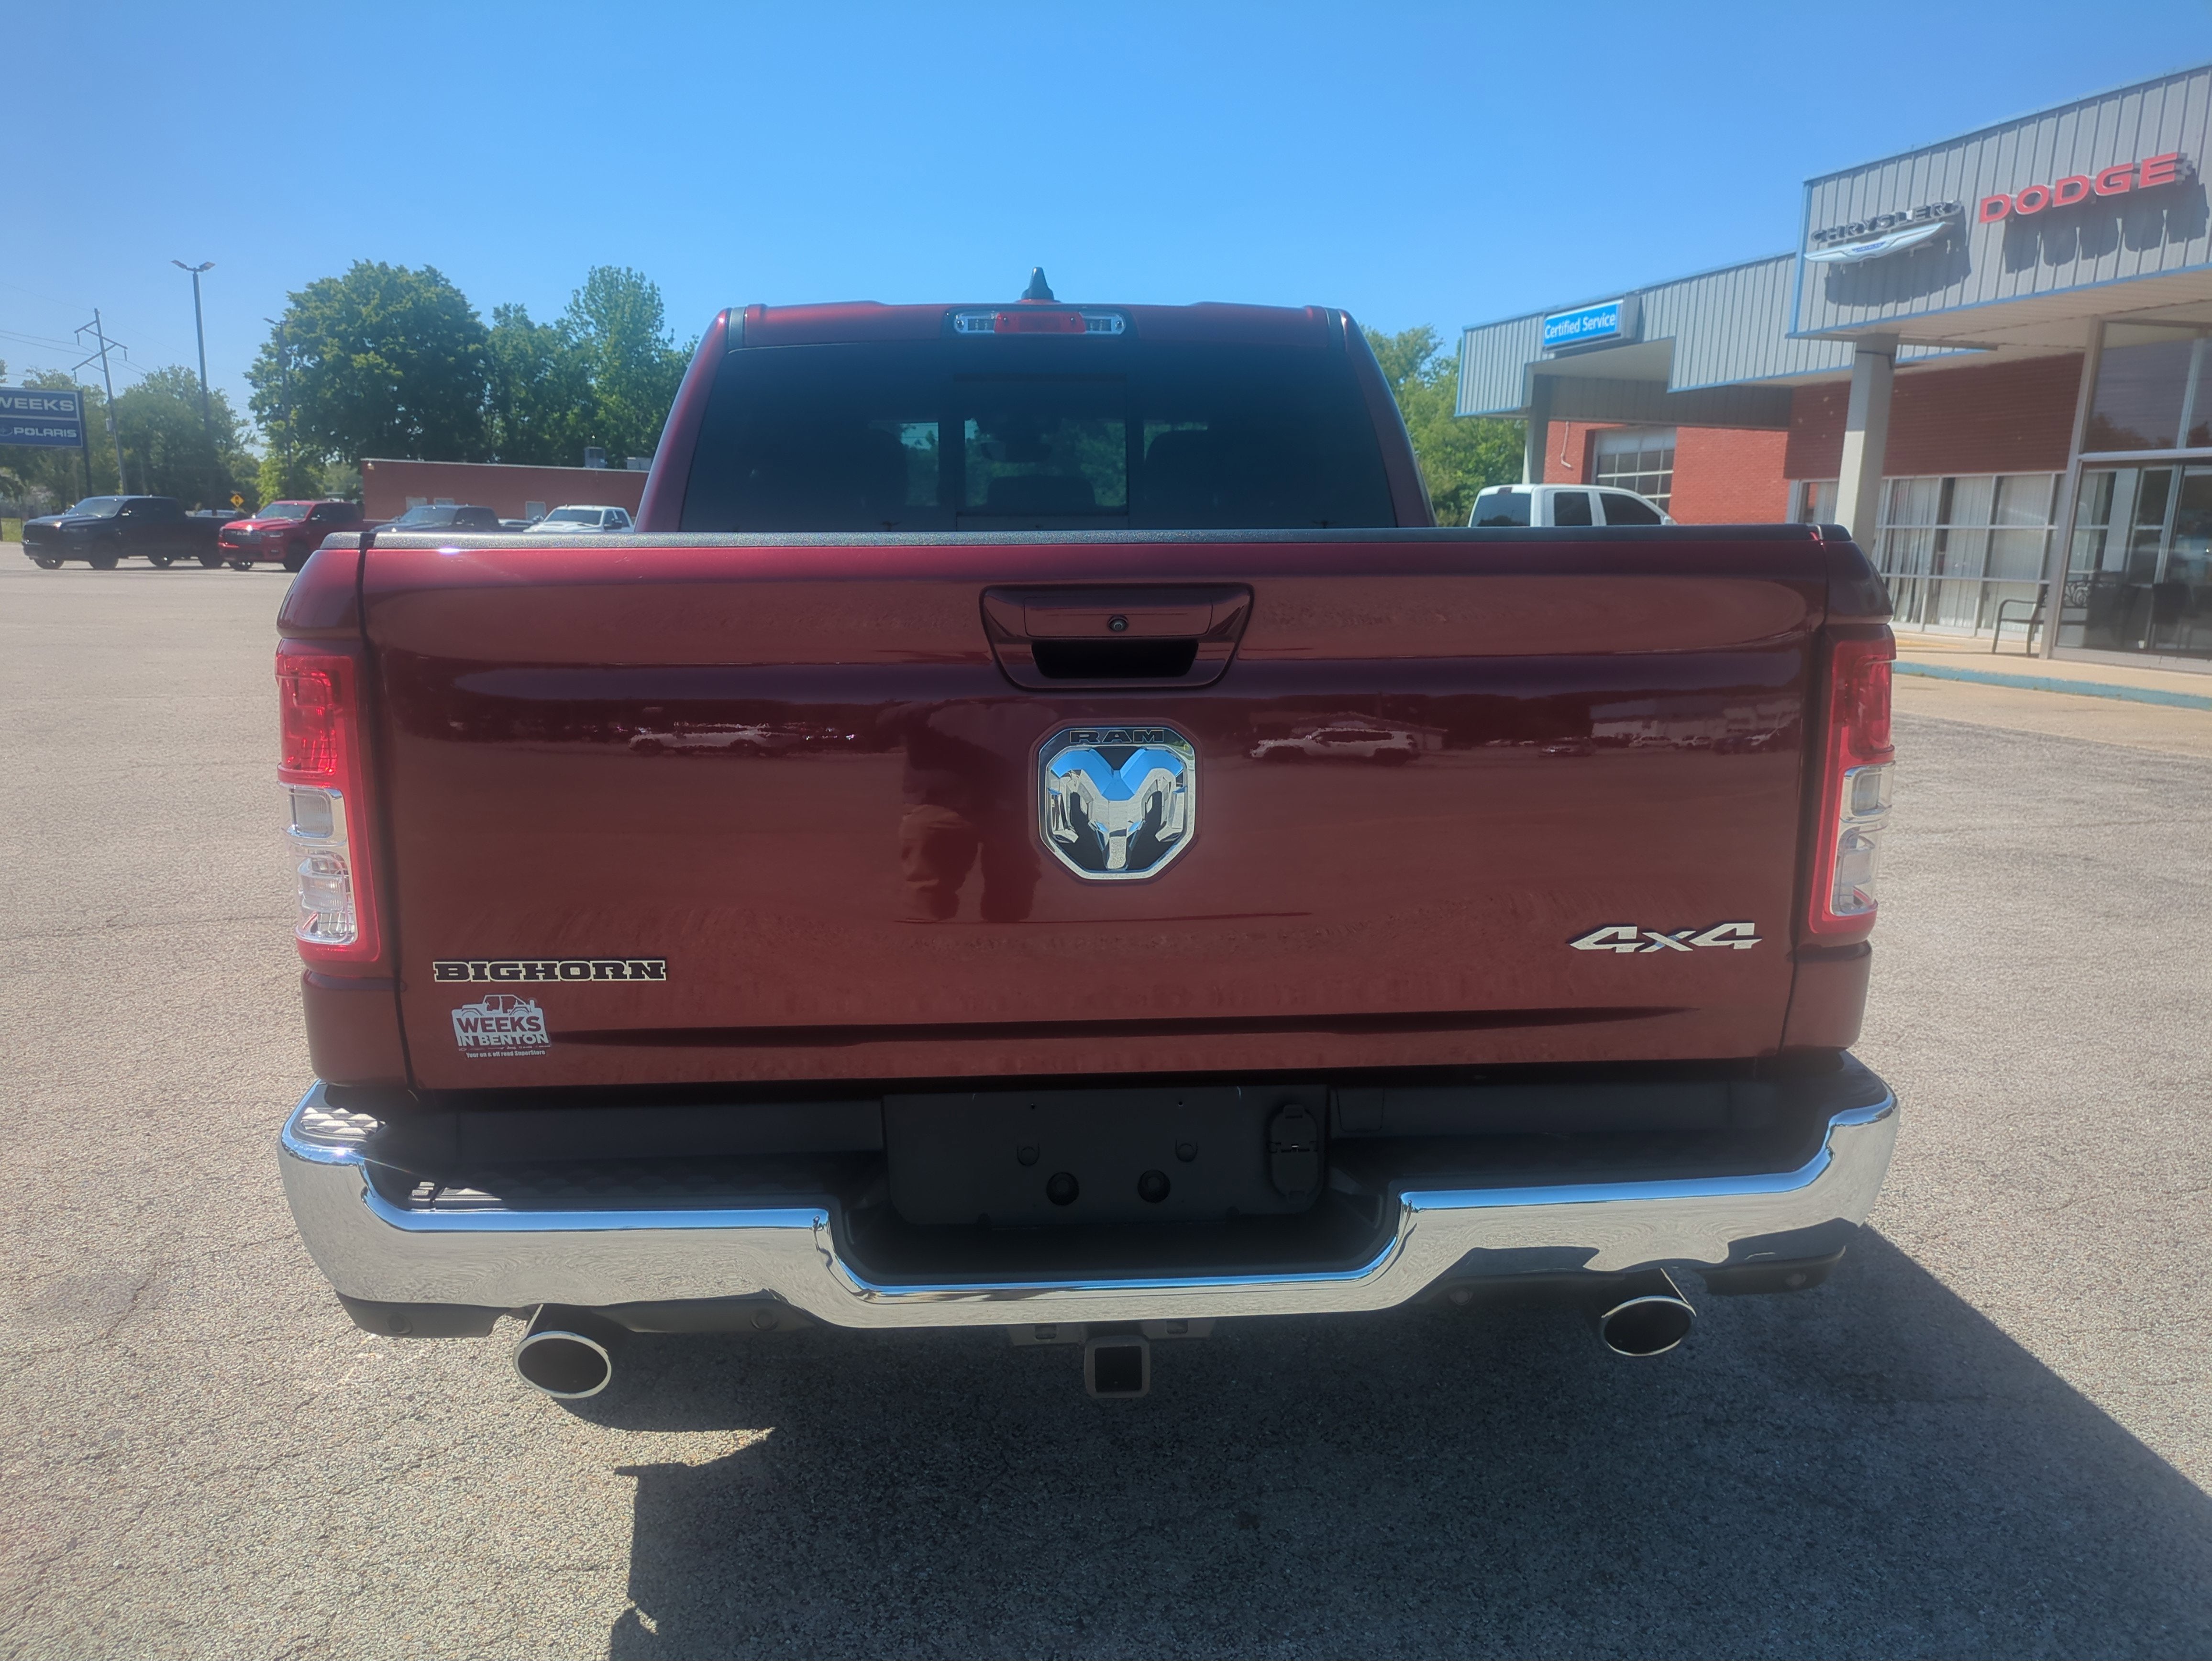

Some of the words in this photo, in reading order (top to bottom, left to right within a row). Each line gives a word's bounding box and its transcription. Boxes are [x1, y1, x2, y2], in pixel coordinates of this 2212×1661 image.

[1979, 152, 2179, 223] DODGE
[1811, 201, 1957, 241] CHRYSLER
[1544, 318, 1581, 339] Certified
[1582, 312, 1615, 332] Service
[13, 427, 77, 438] POLARIS
[1070, 730, 1164, 743] RAM
[432, 960, 667, 982] BIGHORN
[456, 1016, 542, 1033] WEEKS
[458, 1035, 475, 1047] IN
[478, 1034, 549, 1046] BENTON
